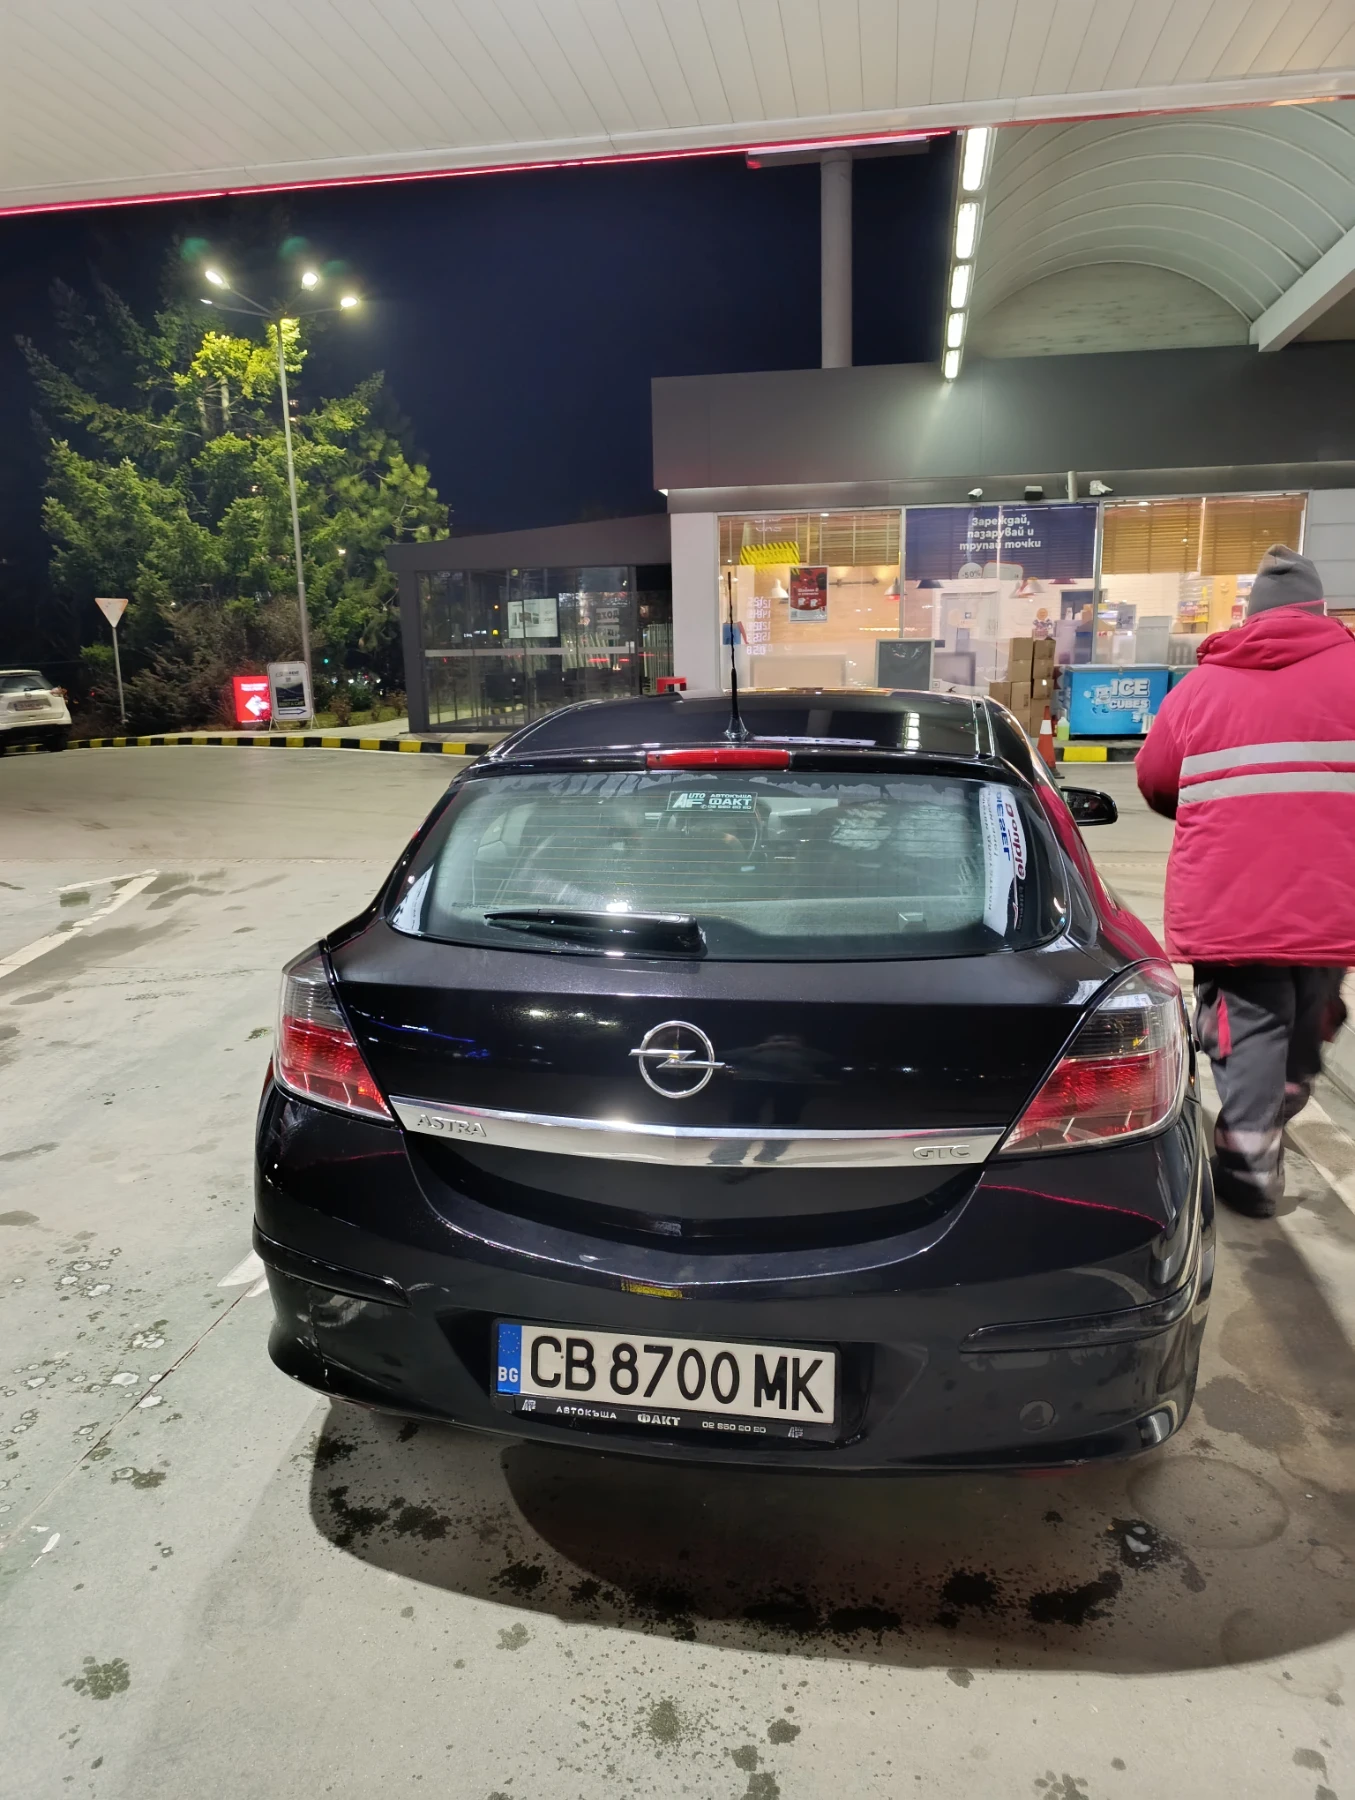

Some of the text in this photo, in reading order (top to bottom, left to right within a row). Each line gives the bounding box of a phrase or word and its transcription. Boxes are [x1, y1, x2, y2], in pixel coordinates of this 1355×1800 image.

[971, 514, 1030, 528] Зареждай,
[967, 526, 1034, 539] пазарувай и
[959, 538, 1042, 552] трупай точки
[1110, 678, 1150, 698] ICE
[1108, 698, 1150, 711] CUBES
[416, 1113, 487, 1138] ASTRA
[912, 1144, 971, 1160] GTC
[497, 1366, 519, 1384] BG
[529, 1335, 824, 1414] CB 8700 MK
[555, 1405, 618, 1420] АВТОКЪША
[637, 1413, 681, 1427] ФАКТ
